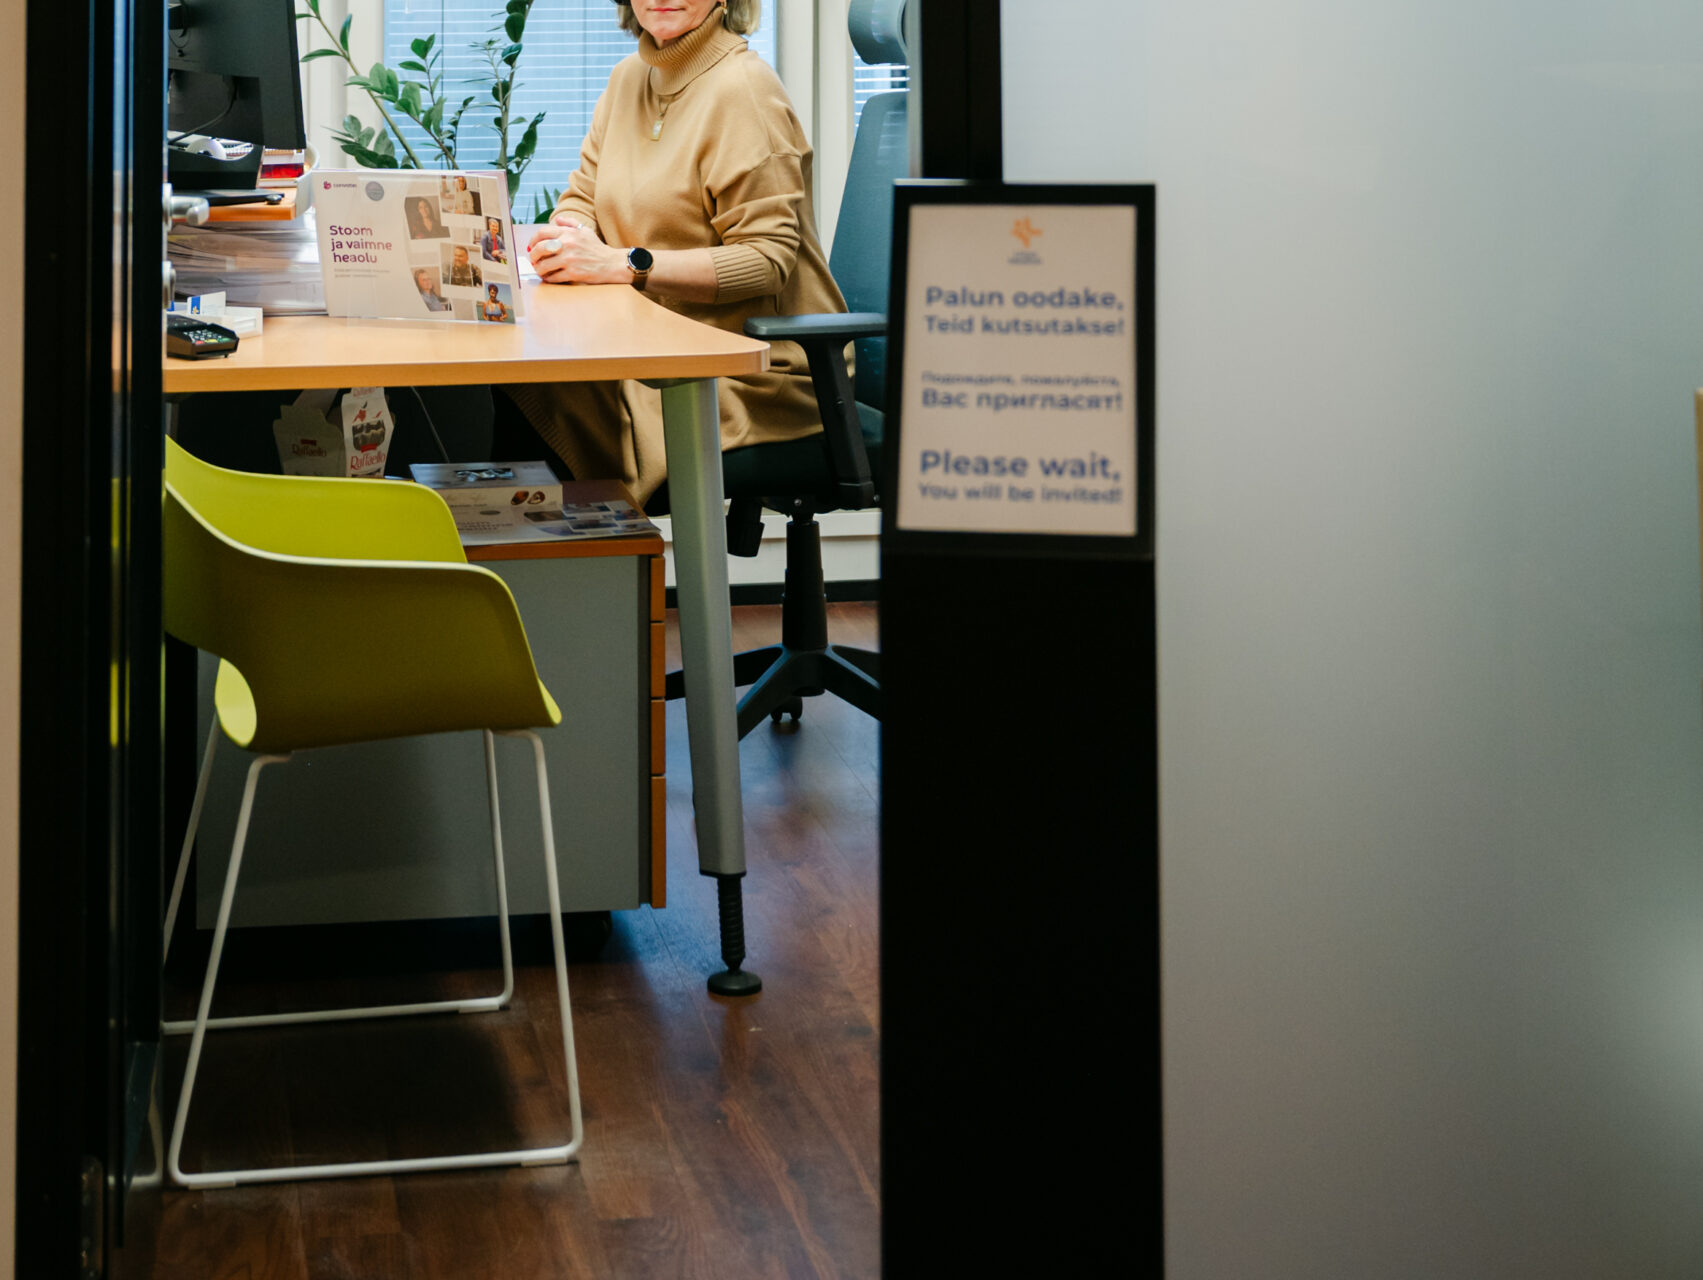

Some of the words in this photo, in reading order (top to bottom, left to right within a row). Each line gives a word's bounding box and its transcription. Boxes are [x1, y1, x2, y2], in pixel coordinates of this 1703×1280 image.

[329, 225, 373, 236] Stoom
[331, 239, 343, 251] ja
[345, 238, 392, 251] vaimne
[333, 252, 377, 264] heaolu
[925, 286, 1004, 307] Palun
[1012, 288, 1124, 311] oodake,
[924, 315, 974, 334] Teid
[921, 388, 967, 408] Вас
[920, 450, 1029, 477] Please
[1039, 451, 1121, 481] wait,
